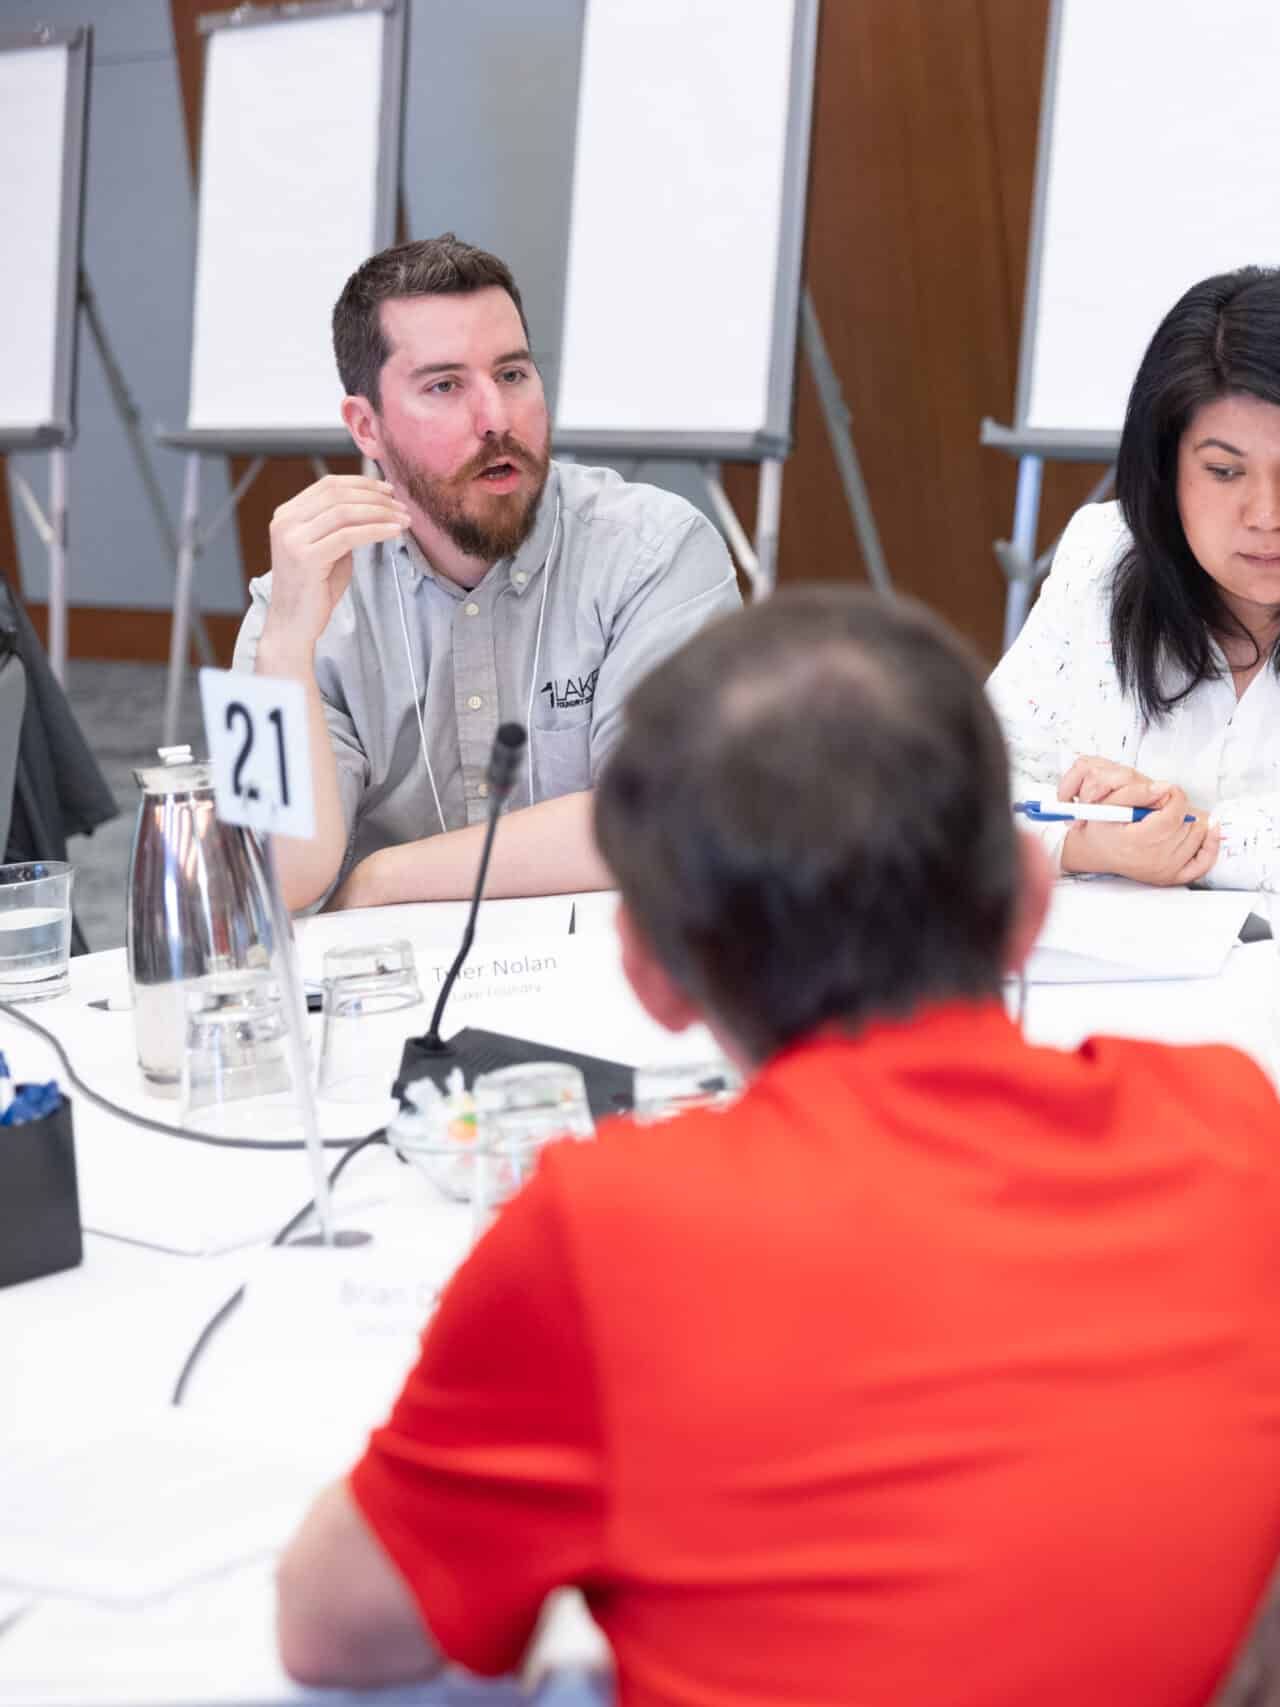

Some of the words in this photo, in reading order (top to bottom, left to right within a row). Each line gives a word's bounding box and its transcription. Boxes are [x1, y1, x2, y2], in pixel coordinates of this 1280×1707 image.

[225, 701, 290, 806] 21
[432, 963, 484, 983] Ter
[492, 955, 558, 977] Nolan
